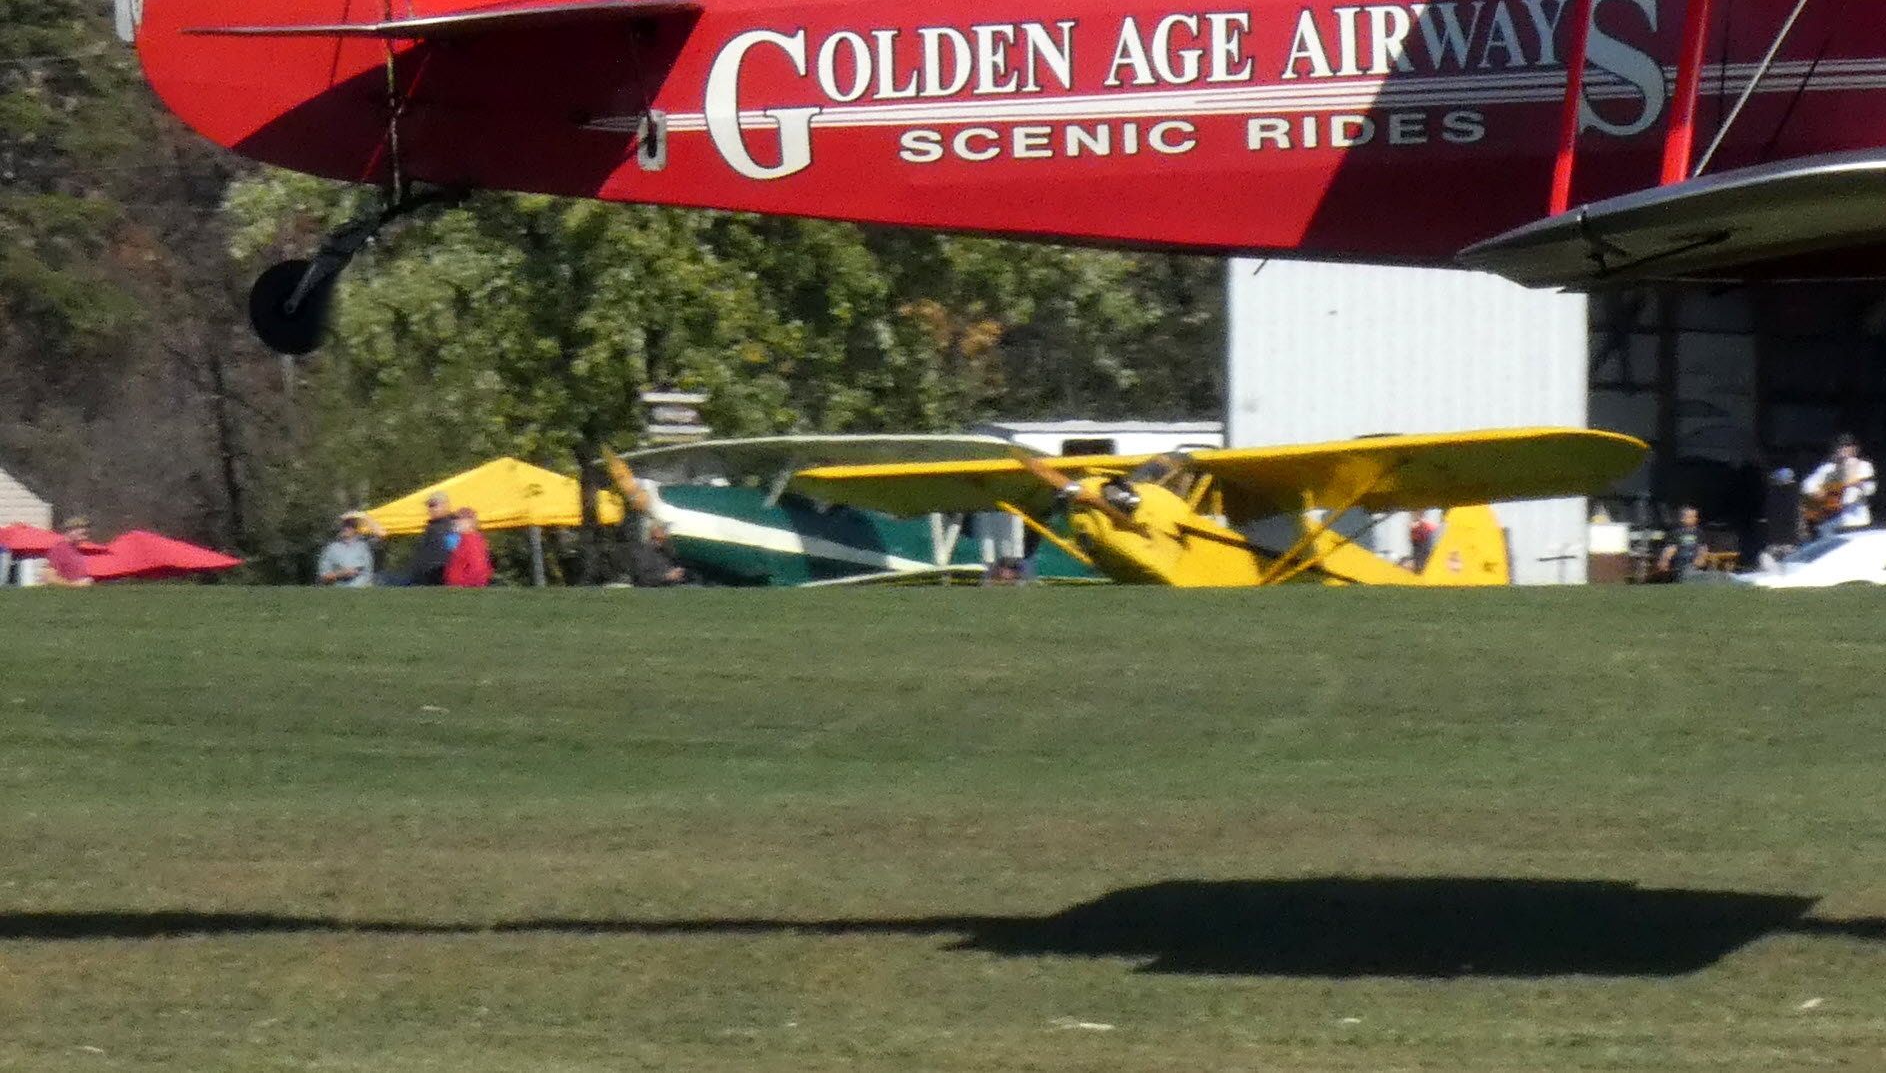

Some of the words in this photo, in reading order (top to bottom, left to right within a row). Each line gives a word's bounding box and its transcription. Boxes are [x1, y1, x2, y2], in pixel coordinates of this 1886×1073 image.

[704, 19, 1077, 181] GOLDEN
[1104, 10, 1254, 86] AGE
[899, 120, 1197, 164] SCENIC
[1247, 111, 1487, 151] RIDES
